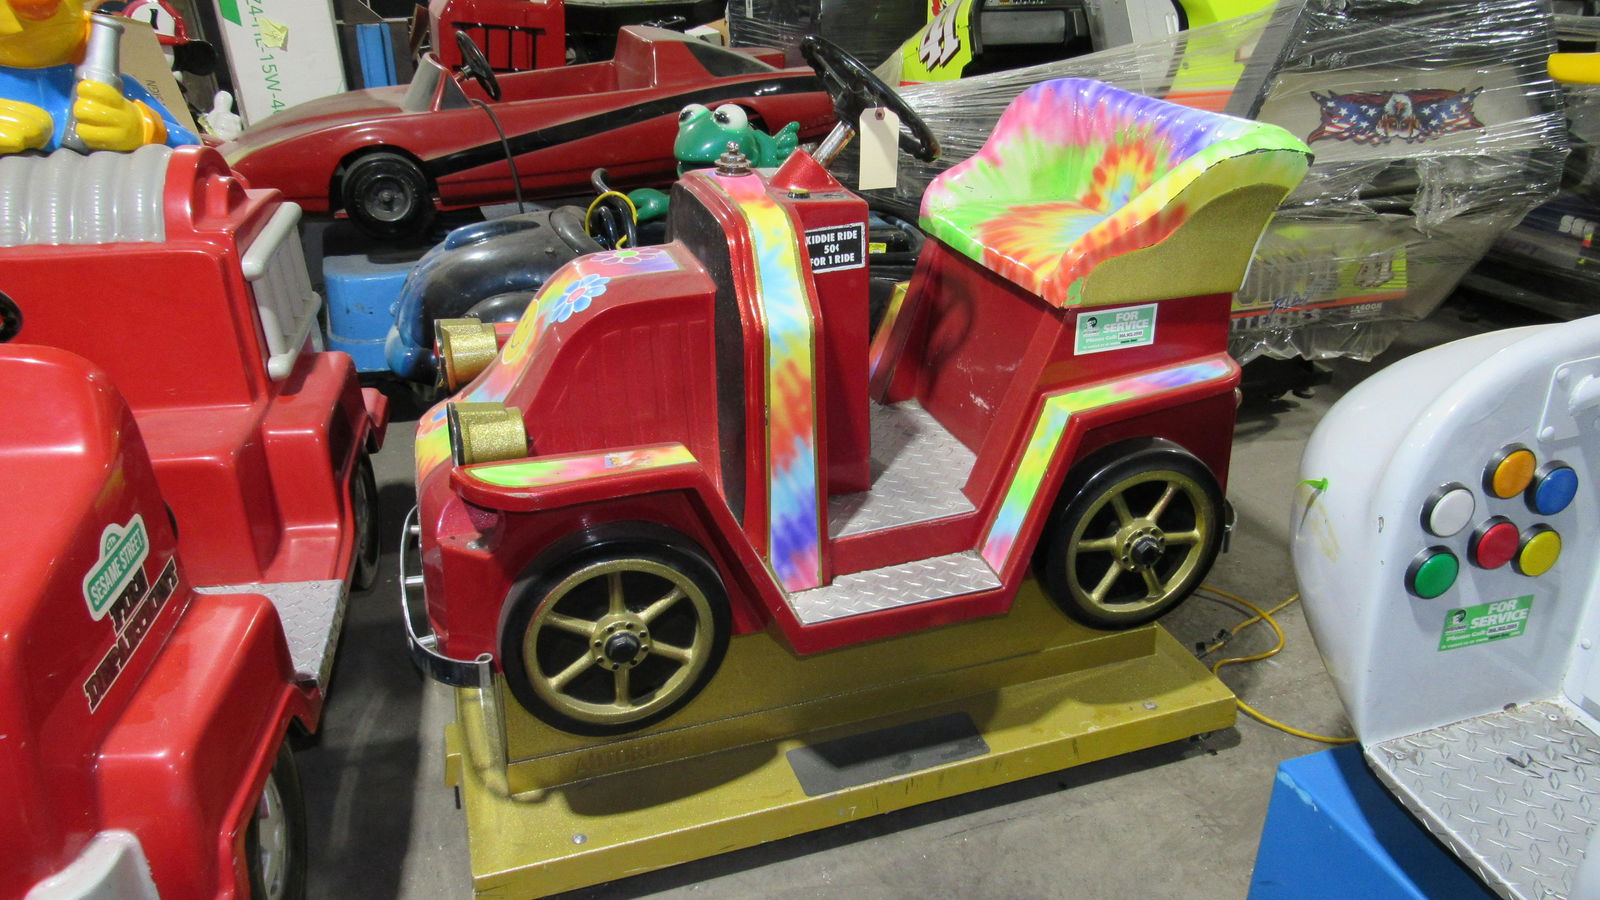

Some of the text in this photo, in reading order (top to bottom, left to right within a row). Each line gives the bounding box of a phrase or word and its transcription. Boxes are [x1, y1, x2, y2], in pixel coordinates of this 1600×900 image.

[918, 2, 961, 72] 41
[805, 230, 858, 245] KIDDIE RIDE
[824, 243, 840, 254] 50¢
[828, 255, 833, 265] 1
[835, 252, 855, 264] RIDE
[1116, 311, 1139, 323] FOR
[1103, 319, 1149, 334] SERVICE
[90, 528, 144, 606] SESAME STREET
[1488, 599, 1518, 615] FOR
[1470, 608, 1529, 629] SERVICE
